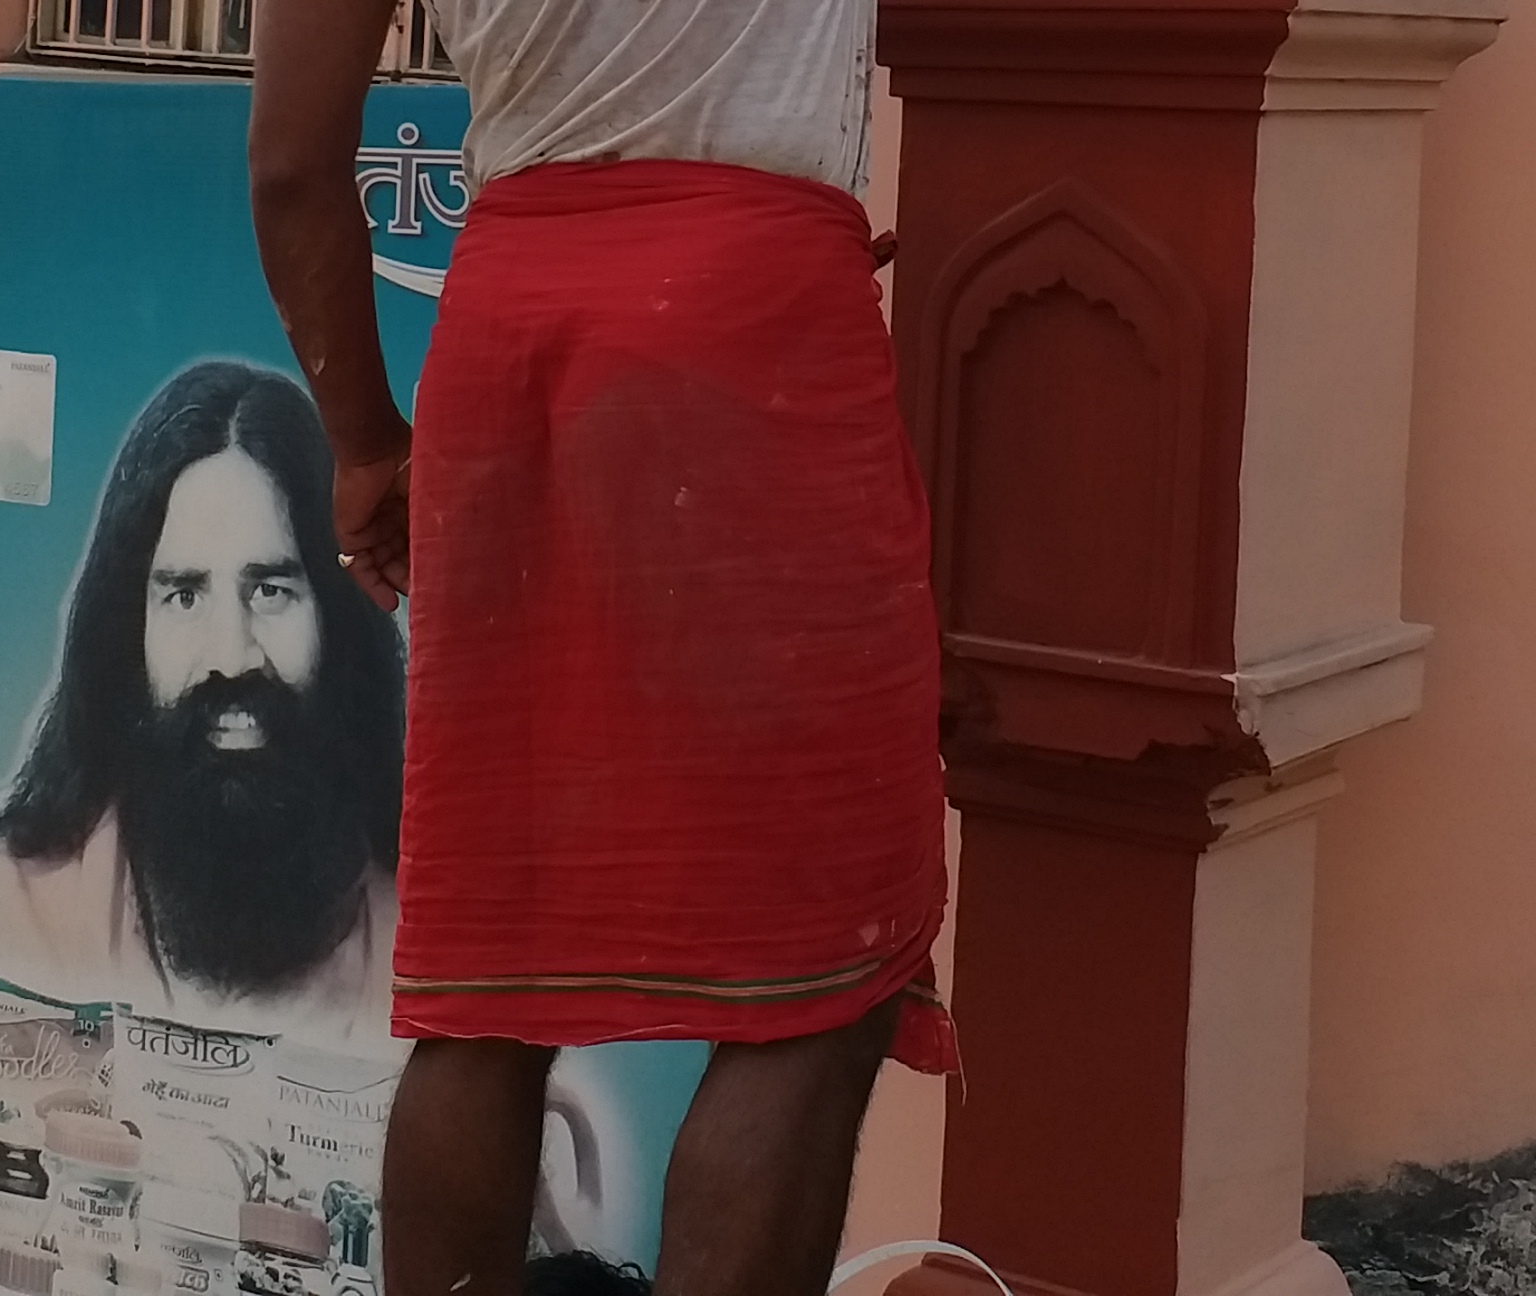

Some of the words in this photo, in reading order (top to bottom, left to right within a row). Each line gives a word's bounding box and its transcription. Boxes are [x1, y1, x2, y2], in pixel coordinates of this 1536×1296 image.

[77, 1019, 95, 1032] 10
[125, 1025, 251, 1069] पतंजलि
[278, 1085, 384, 1123] PATANJALI
[283, 1122, 375, 1160] Turmeric
